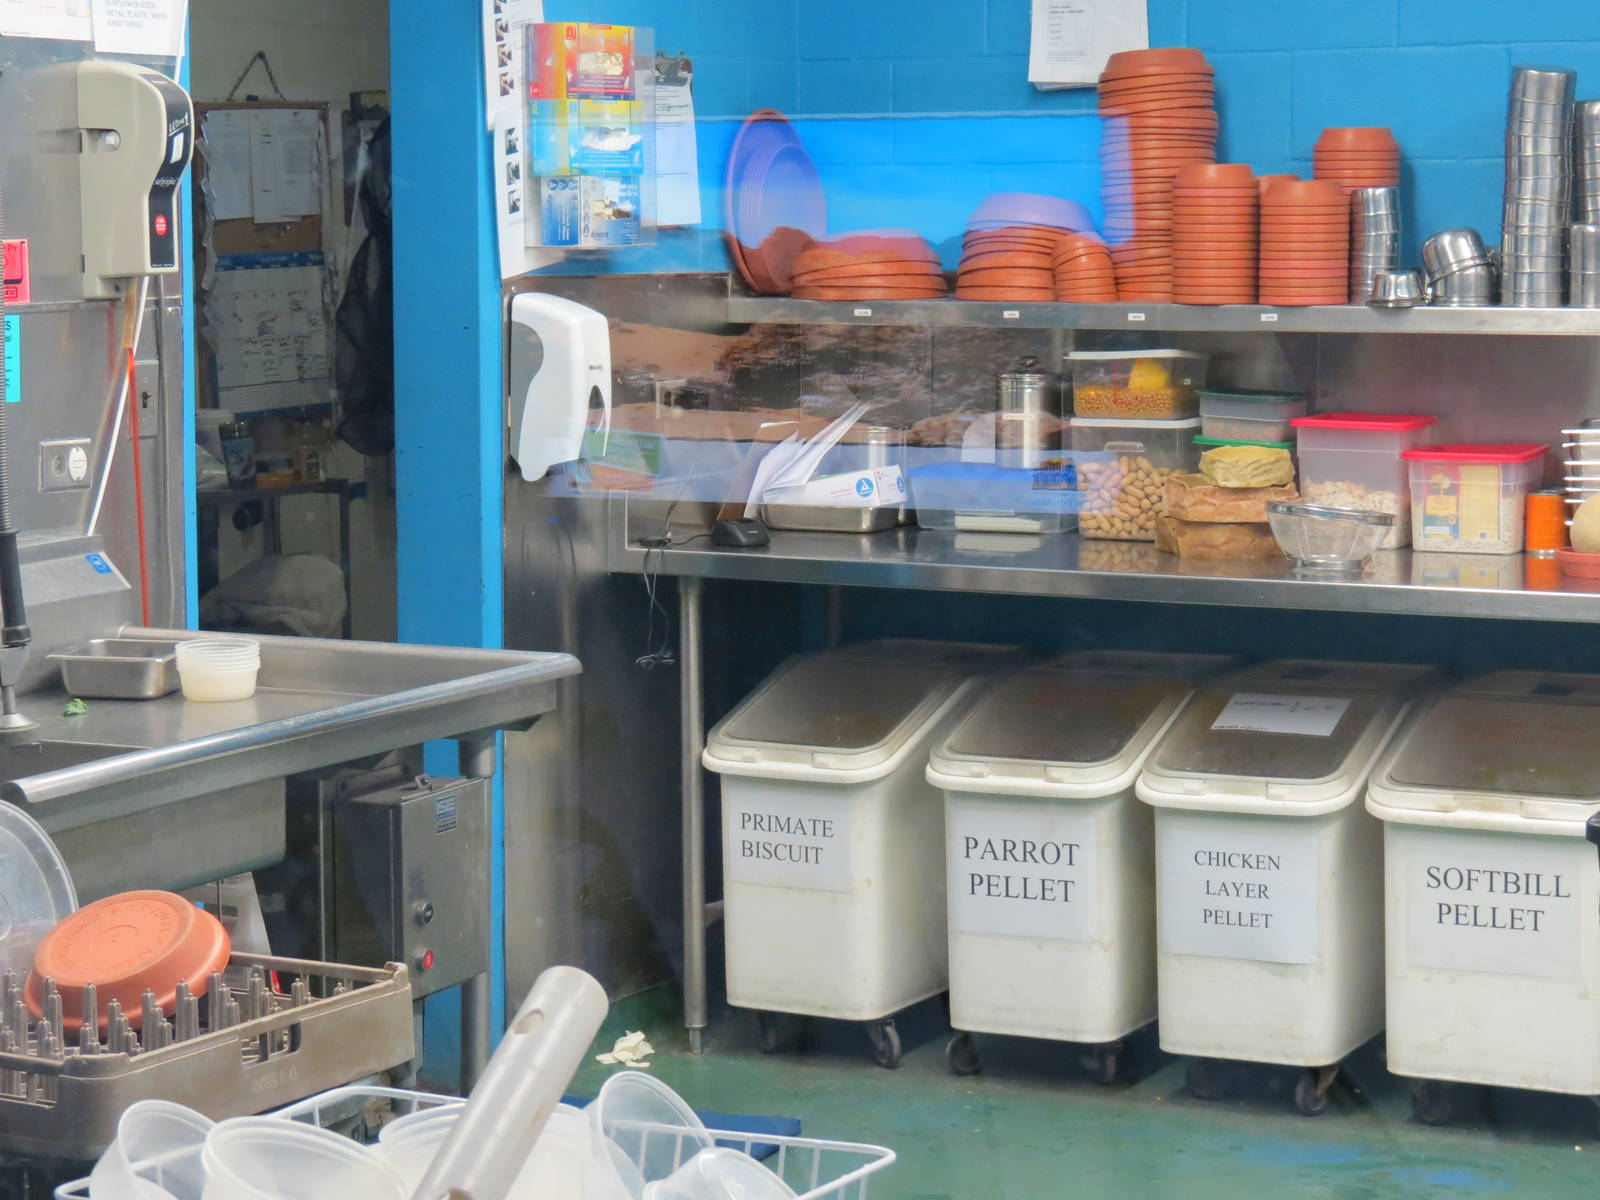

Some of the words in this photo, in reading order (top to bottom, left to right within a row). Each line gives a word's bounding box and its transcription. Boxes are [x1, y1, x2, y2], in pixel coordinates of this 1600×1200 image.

[741, 812, 835, 838] PRIMATE
[741, 839, 824, 865] BISCUIT
[964, 836, 1081, 867] PARROT
[1193, 850, 1281, 871] CHICKEN
[969, 872, 1076, 903] PELLET
[1205, 879, 1270, 900] LAYER
[1426, 865, 1571, 899] SOFTBILL
[1203, 908, 1273, 929] PELLET
[1436, 902, 1545, 932] PELLET
